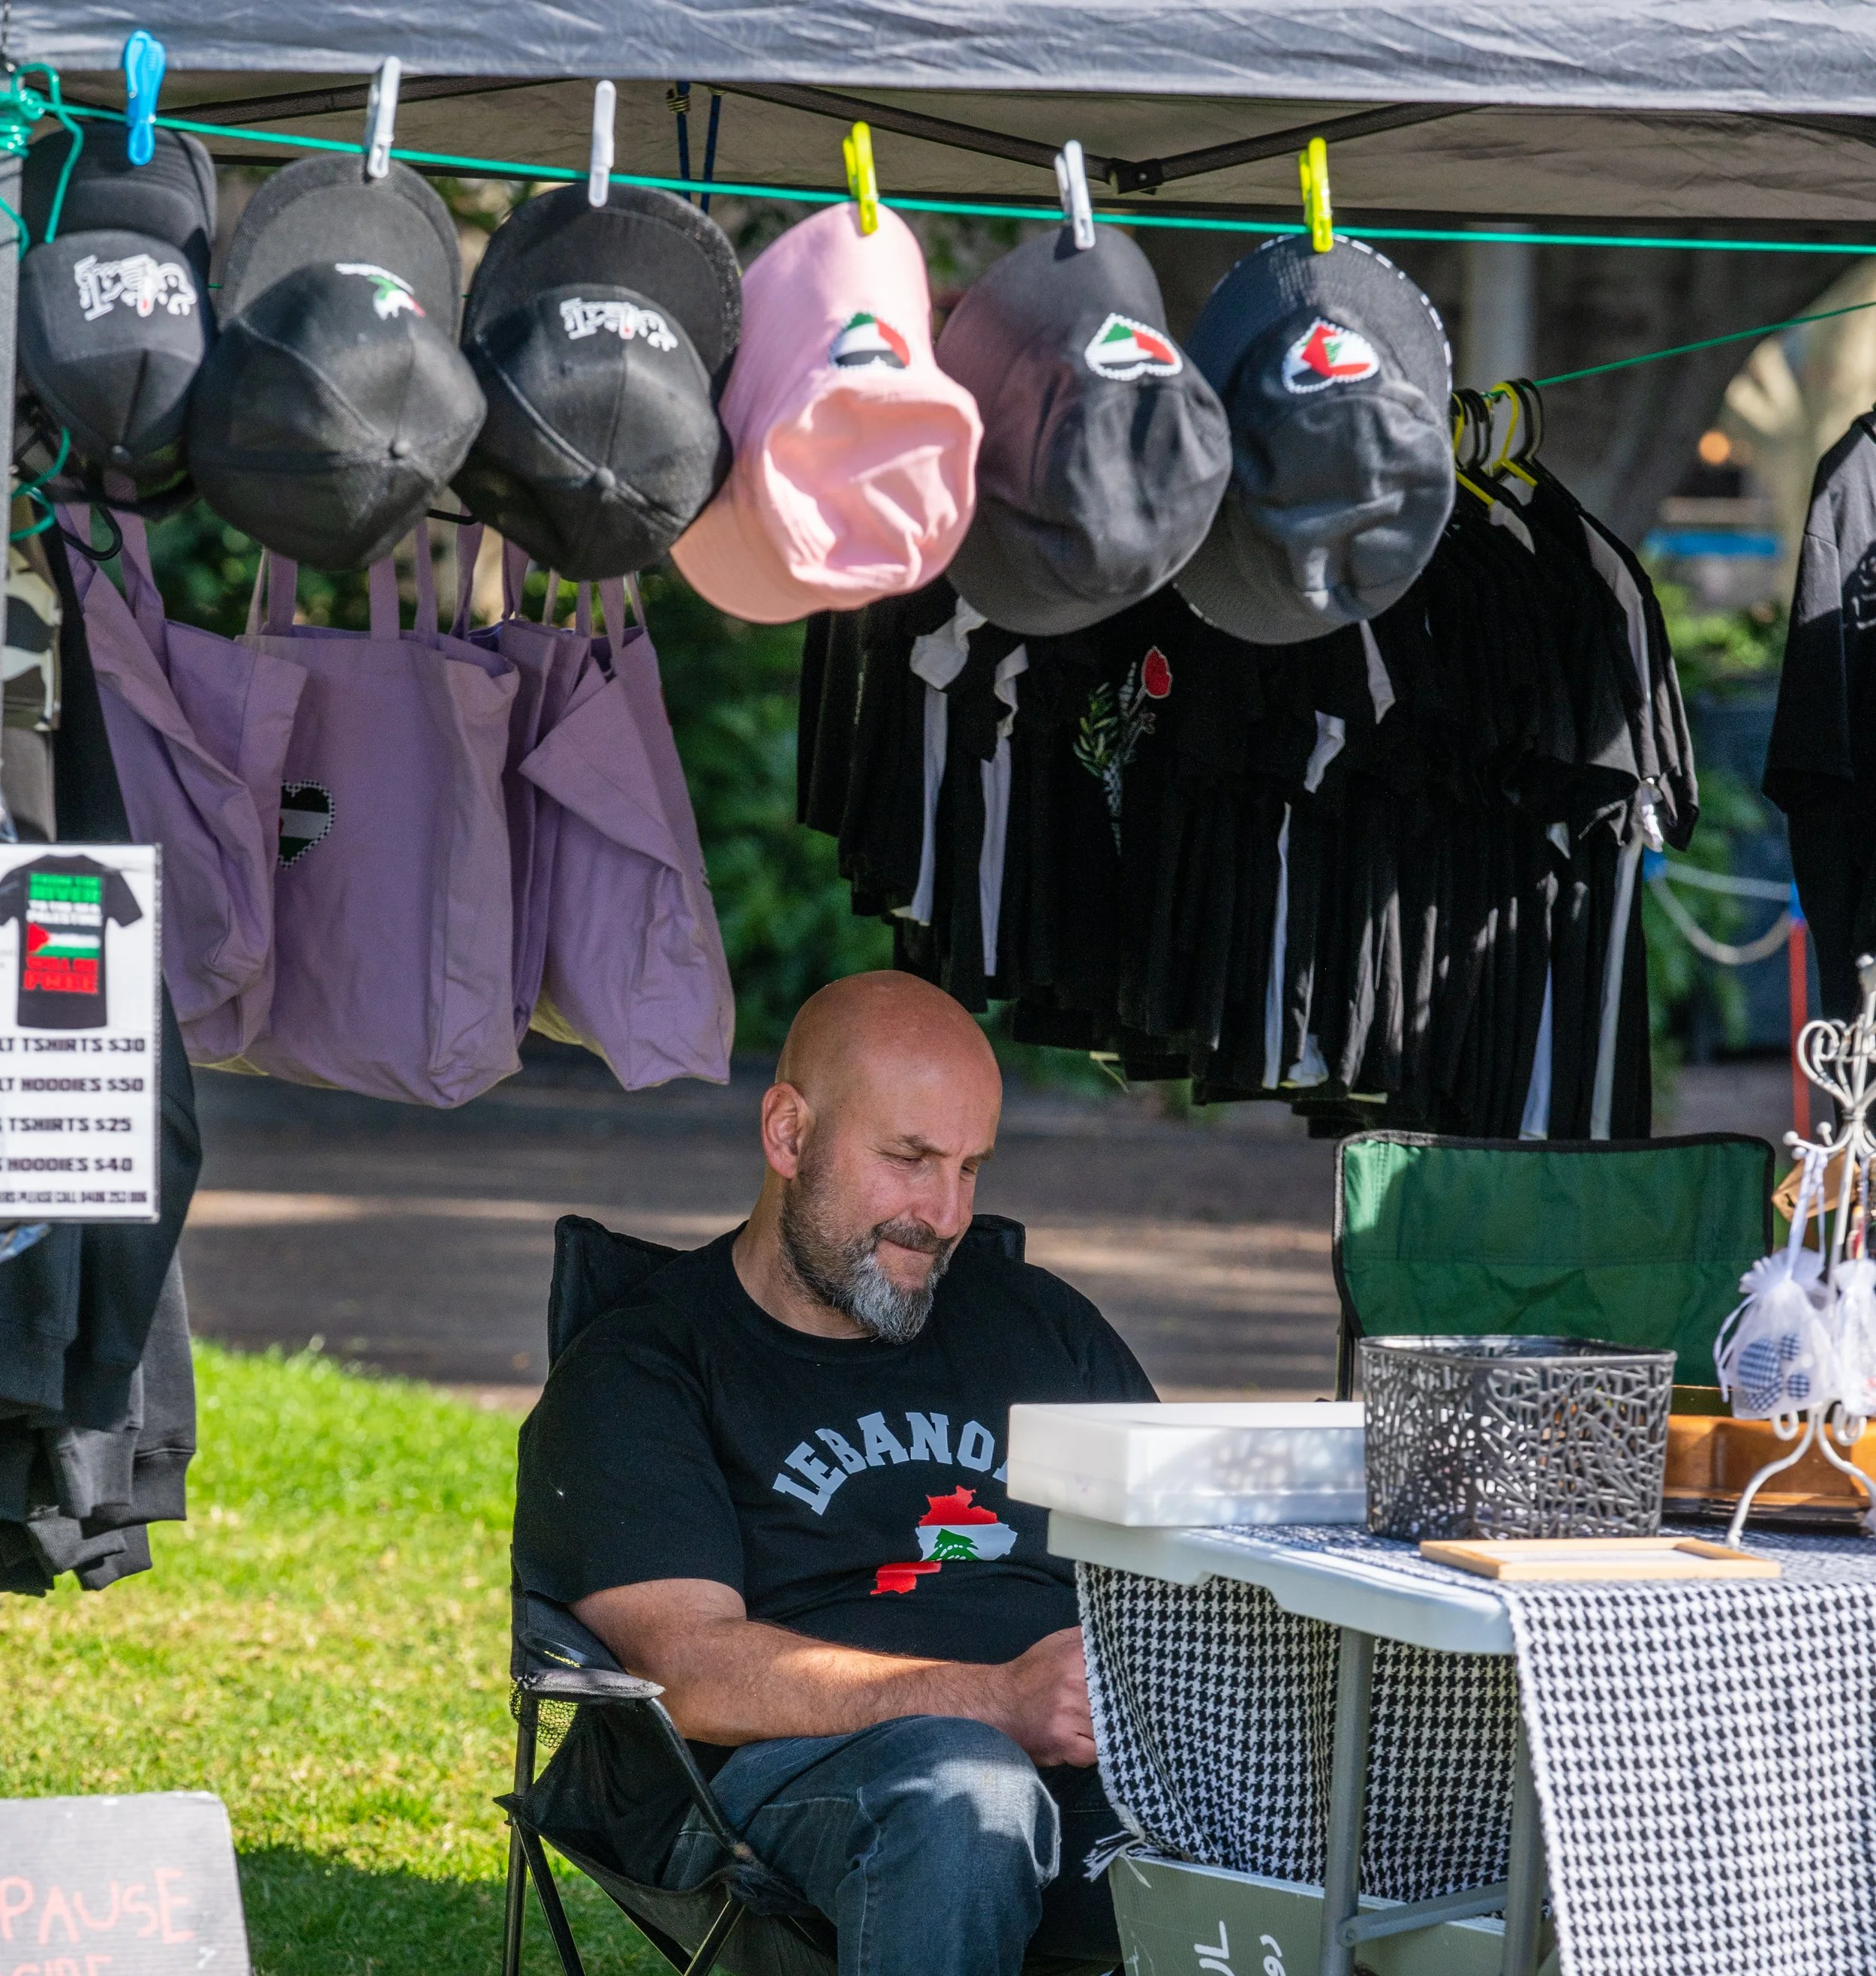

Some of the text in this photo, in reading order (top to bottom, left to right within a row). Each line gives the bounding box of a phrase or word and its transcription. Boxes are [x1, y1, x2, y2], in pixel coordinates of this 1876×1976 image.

[23, 1037, 103, 1052] TSHIRTS
[20, 1077, 101, 1092] HOODIES
[8, 1117, 89, 1132] TSHIRTS
[7, 1156, 89, 1171] HOODIES
[772, 1412, 1007, 1515] LEBANO
[0, 1869, 195, 1945] PAUSE
